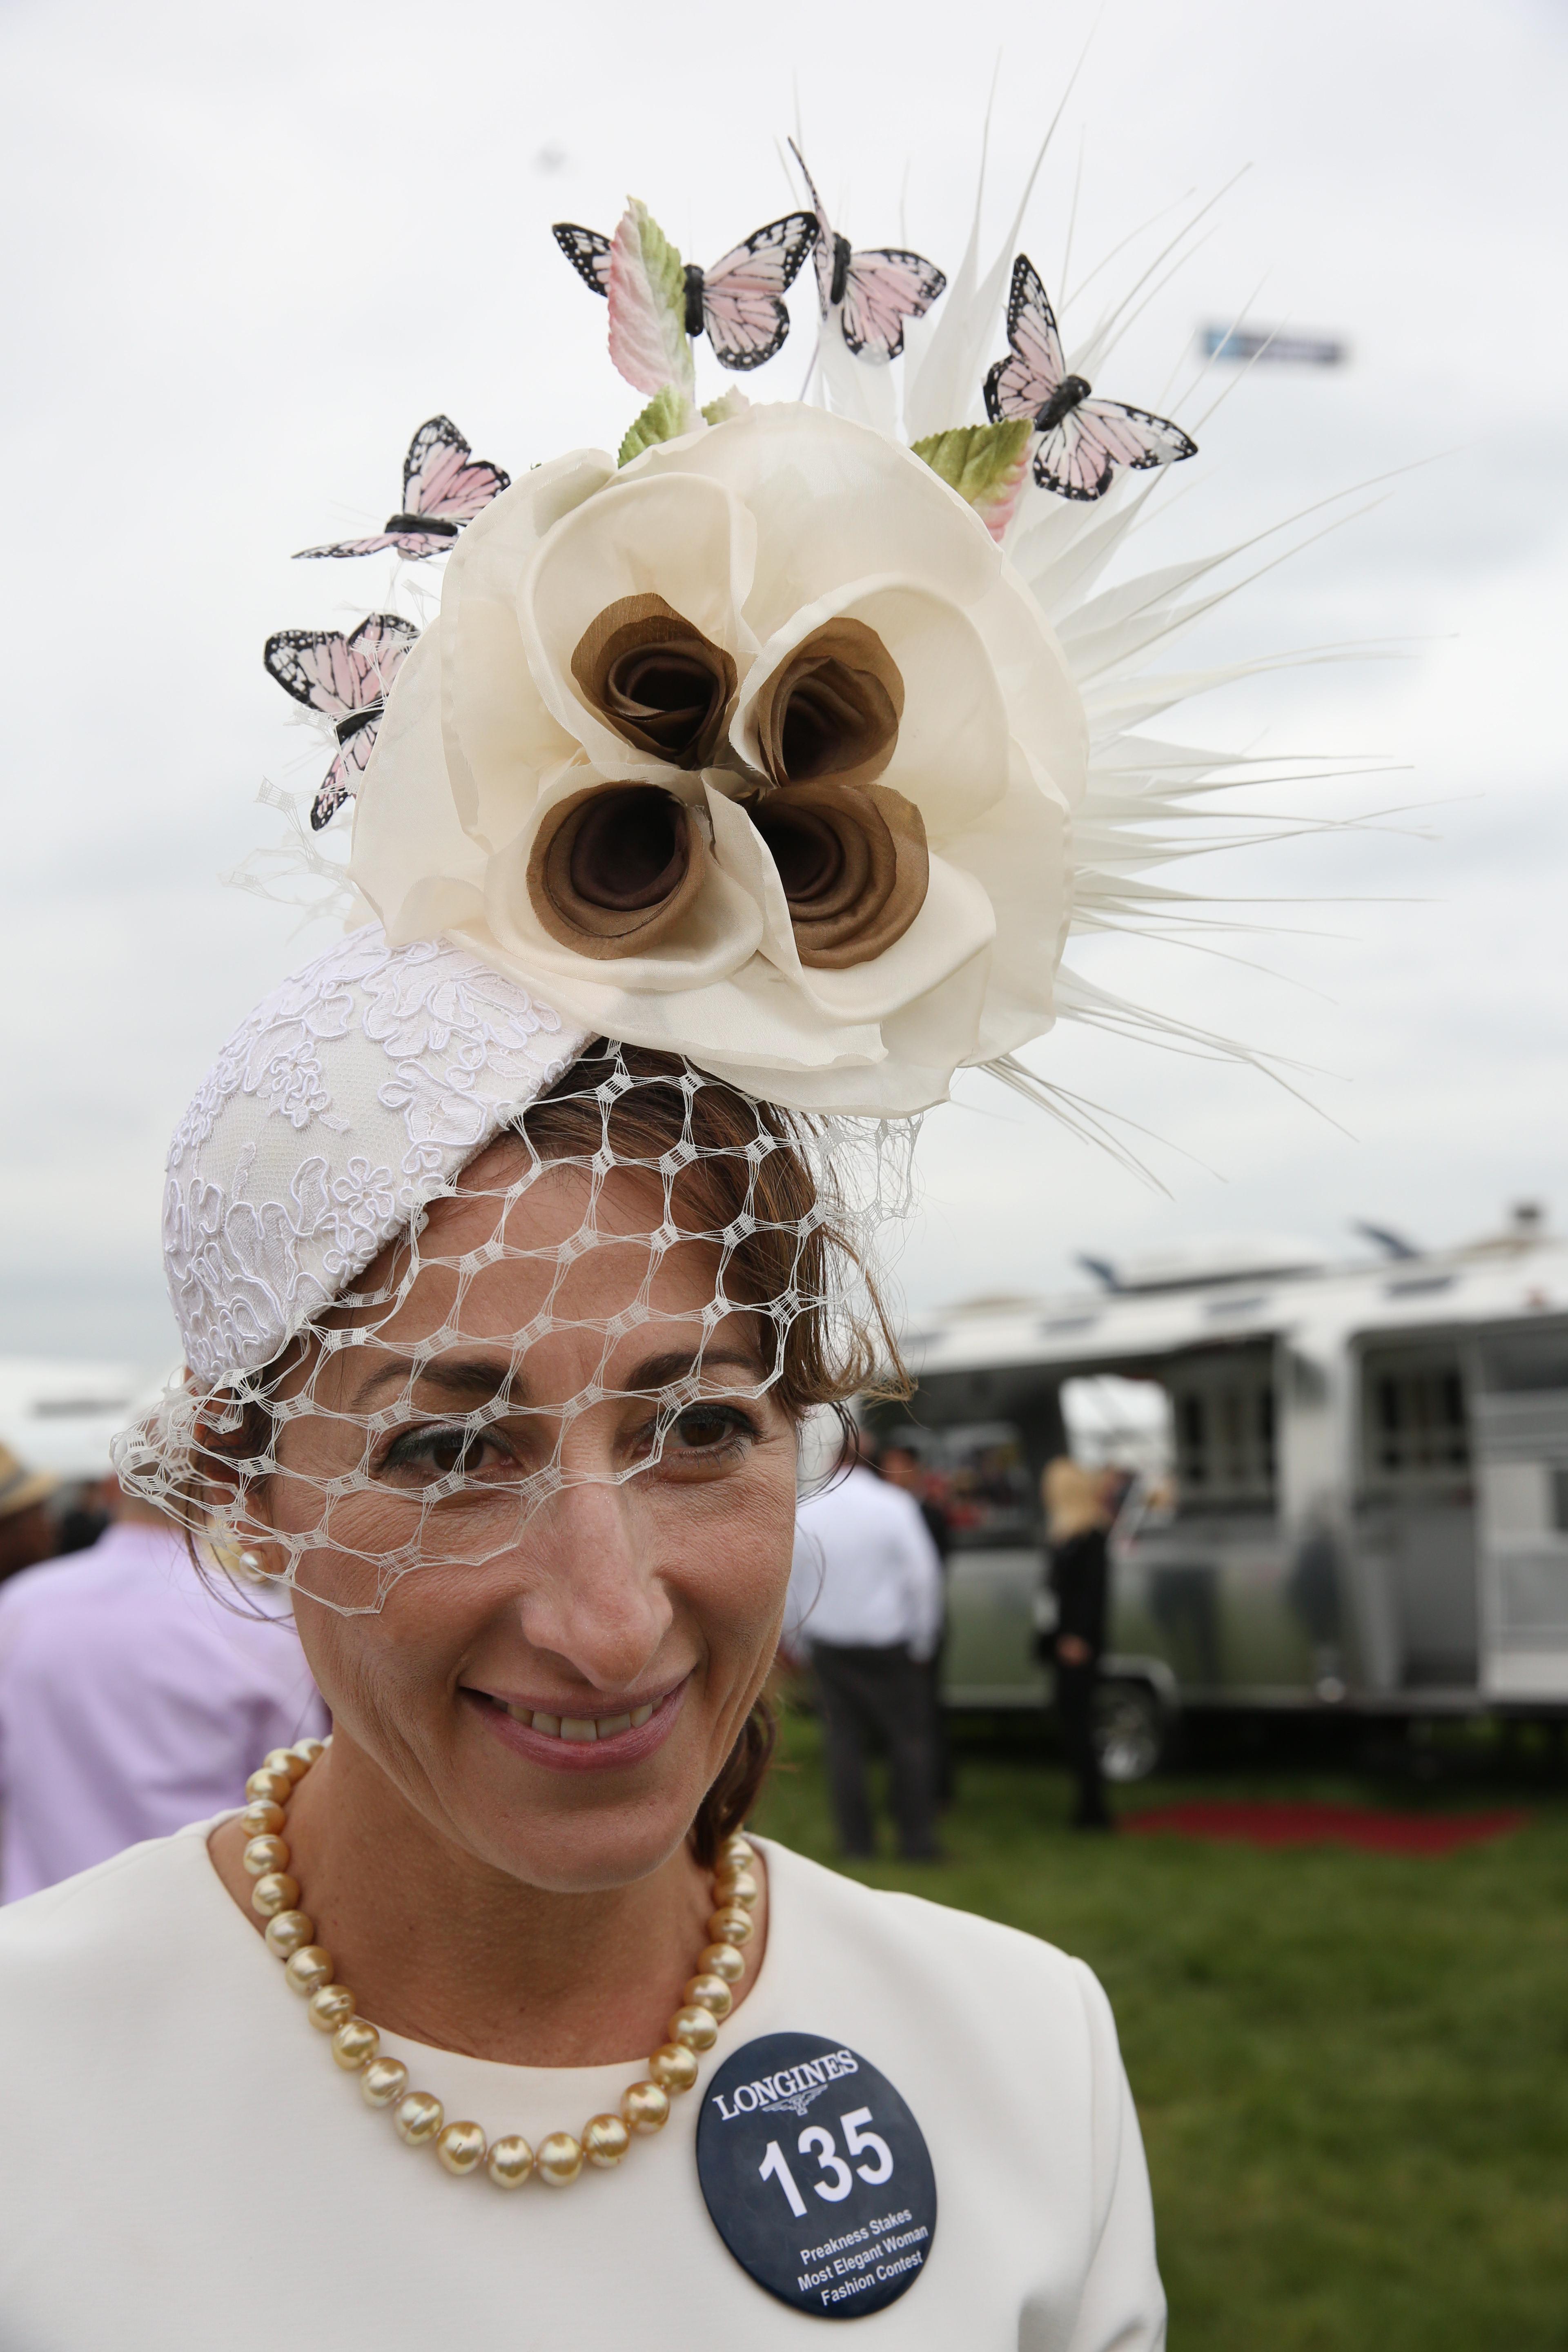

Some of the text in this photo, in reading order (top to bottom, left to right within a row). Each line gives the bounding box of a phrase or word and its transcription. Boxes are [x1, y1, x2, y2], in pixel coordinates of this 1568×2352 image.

[713, 2050, 858, 2120] LONGINES
[759, 2107, 893, 2217] 135
[798, 2226, 928, 2291] Most Elegant Woman
[800, 2209, 912, 2265] Preakness Stakes
[821, 2251, 922, 2305] Fashion Contest
